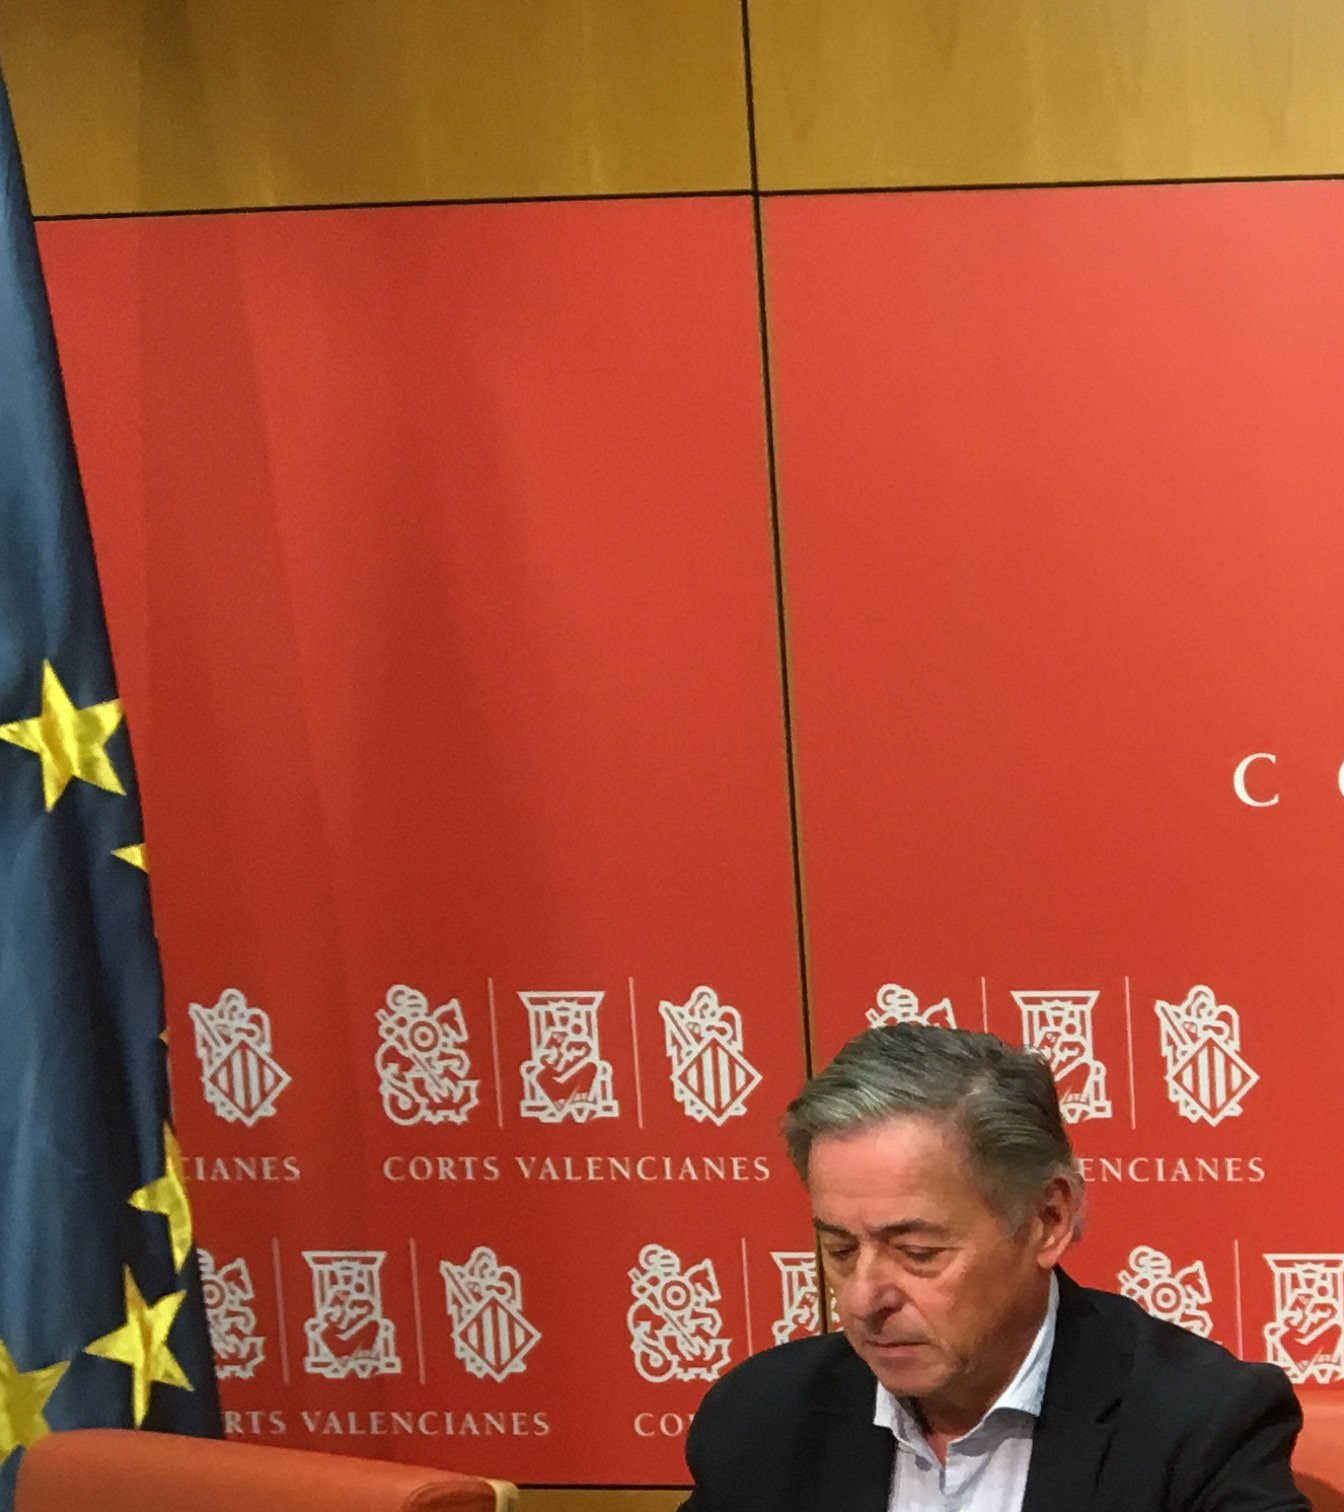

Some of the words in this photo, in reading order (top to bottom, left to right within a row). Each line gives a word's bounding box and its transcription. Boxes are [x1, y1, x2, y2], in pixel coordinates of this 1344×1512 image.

[383, 1156, 500, 1181] CORTS
[516, 1156, 770, 1182] VALENCIANES
[1079, 1156, 1265, 1182] ENCIANES
[224, 1410, 286, 1435] RTS
[301, 1411, 550, 1436] VALENCIANES
